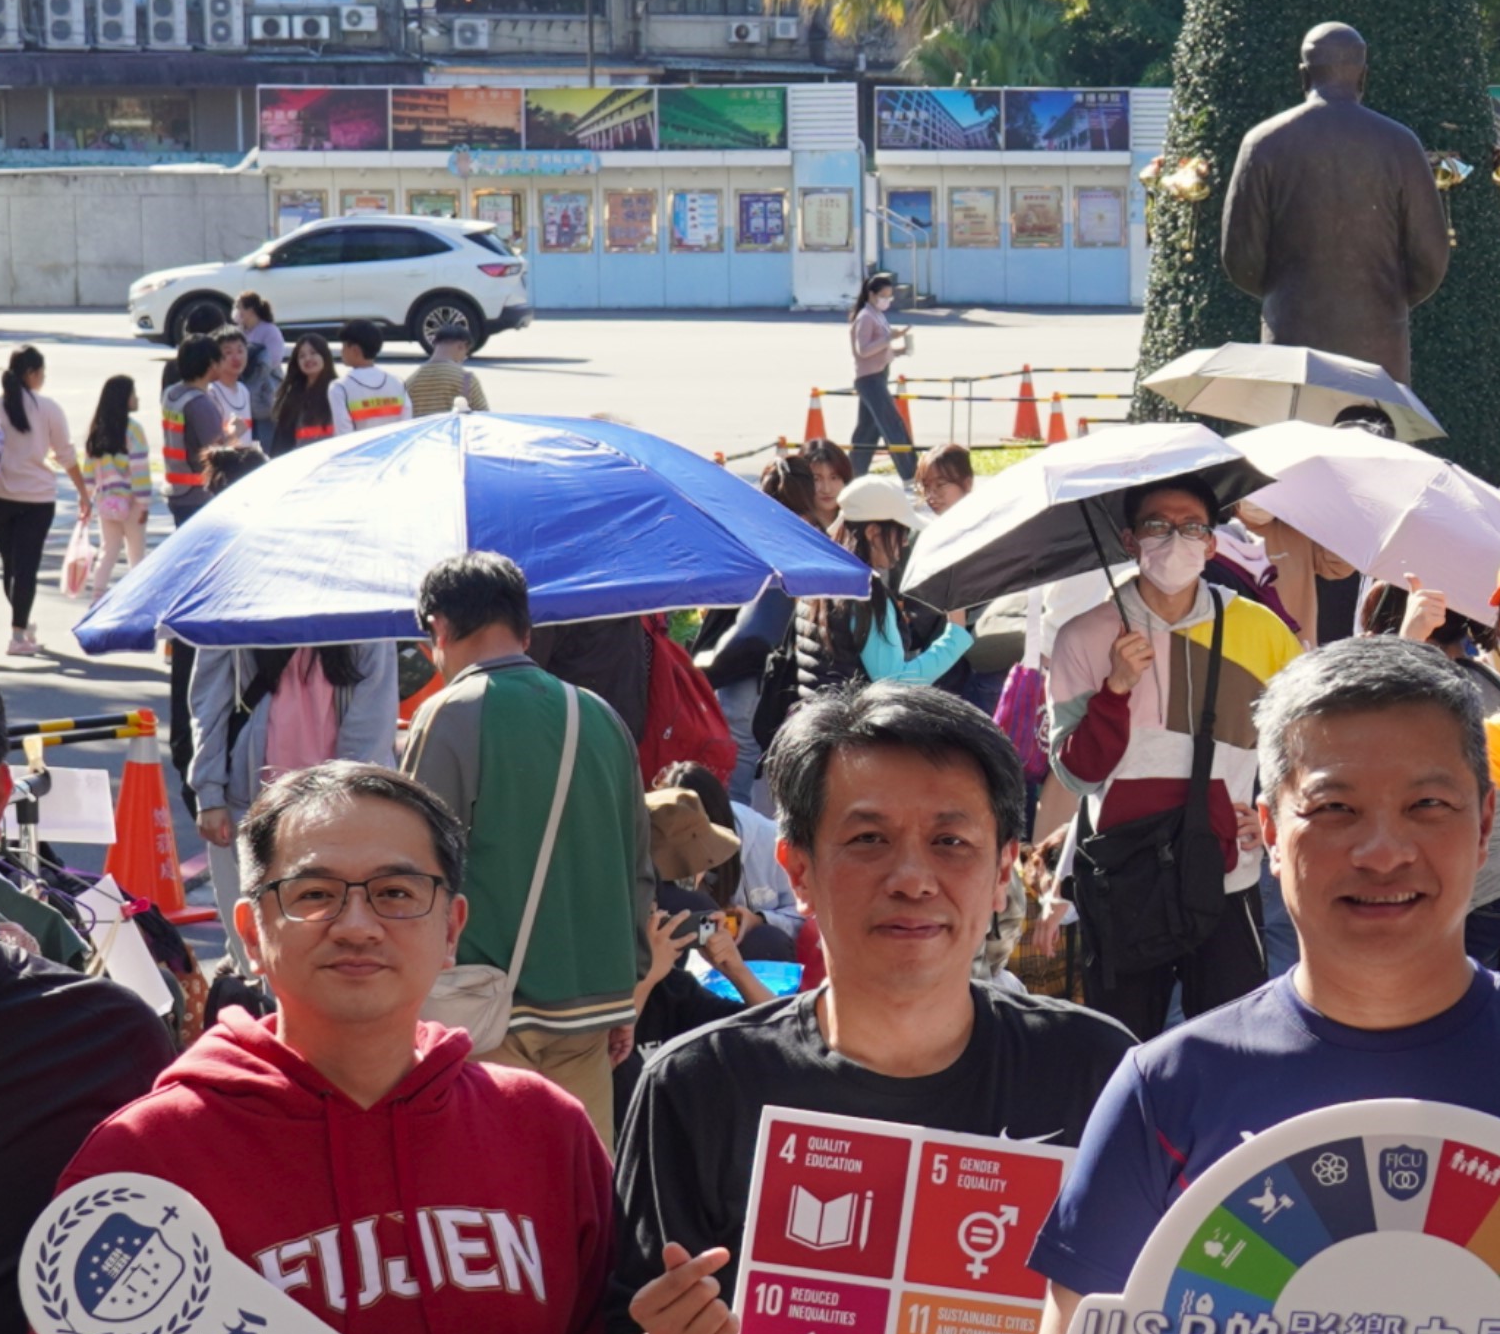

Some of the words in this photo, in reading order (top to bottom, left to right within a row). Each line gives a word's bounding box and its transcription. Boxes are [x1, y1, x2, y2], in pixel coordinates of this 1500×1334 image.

[778, 1133, 797, 1166] 4
[807, 1135, 851, 1155] QUALITY
[1385, 1152, 1424, 1170] FJCU
[804, 1153, 863, 1174] EDUCATION
[930, 1154, 949, 1185] 5
[959, 1156, 1001, 1176] GENDER
[956, 1173, 1007, 1193] EQUALITY
[252, 1205, 548, 1313] FUJEN
[754, 1281, 783, 1316] 10
[790, 1285, 840, 1306] REDUCED
[787, 1304, 857, 1327] INEQUALITIES
[936, 1306, 1003, 1329] SUSTAINABLE
[1004, 1313, 1036, 1332] CITIES
